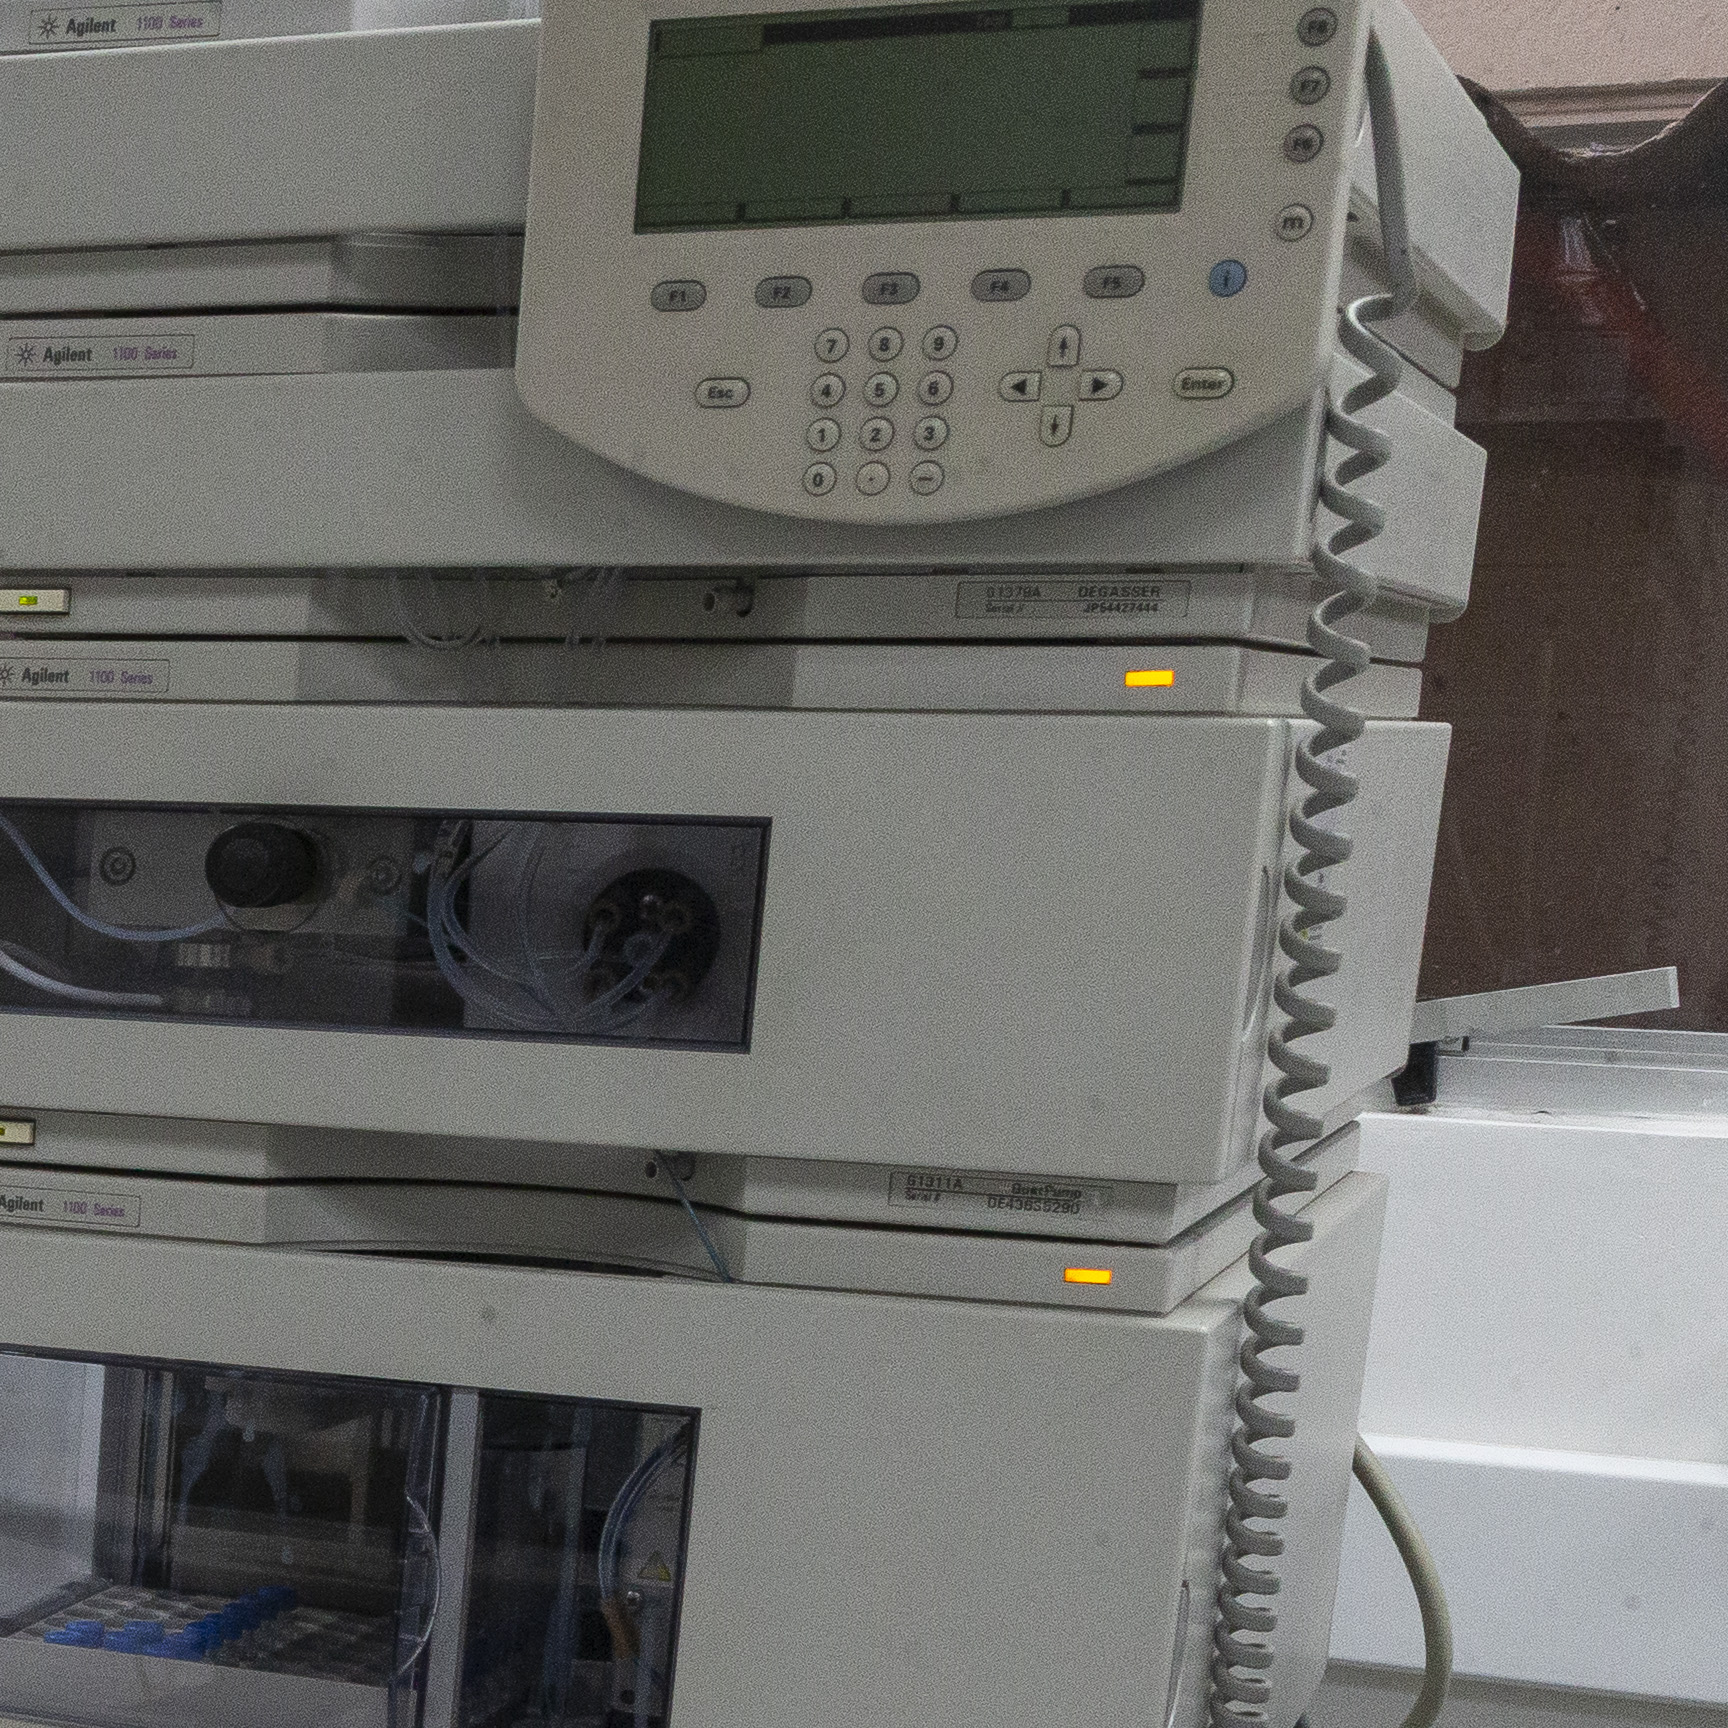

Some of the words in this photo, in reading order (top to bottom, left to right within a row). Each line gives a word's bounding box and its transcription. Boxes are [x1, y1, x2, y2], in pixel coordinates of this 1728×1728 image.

[66, 17, 117, 36] Agilent
[880, 283, 898, 297] F3
[989, 281, 1009, 295] F4
[1102, 275, 1121, 290] F5
[669, 289, 686, 304] F1
[773, 286, 791, 299] F2
[826, 339, 836, 354] 7
[879, 337, 889, 351] 8
[934, 337, 944, 351] 9
[44, 346, 93, 365] Agilent
[114, 347, 138, 361] 1100
[144, 345, 177, 361] Series
[820, 384, 831, 398] 4
[874, 383, 884, 398] 5
[928, 382, 938, 396] 6
[1181, 377, 1225, 392] Enter
[707, 385, 734, 400] Esc
[818, 427, 826, 442] 1
[870, 427, 881, 442] 2
[923, 426, 933, 441] 3
[812, 473, 824, 488] 0
[1077, 585, 1160, 599] DEGASSER
[21, 666, 69, 687] Agilent
[89, 670, 115, 684] 1100
[120, 670, 153, 686] Series
[62, 1200, 87, 1215] 1100
[94, 1202, 125, 1219] Series
